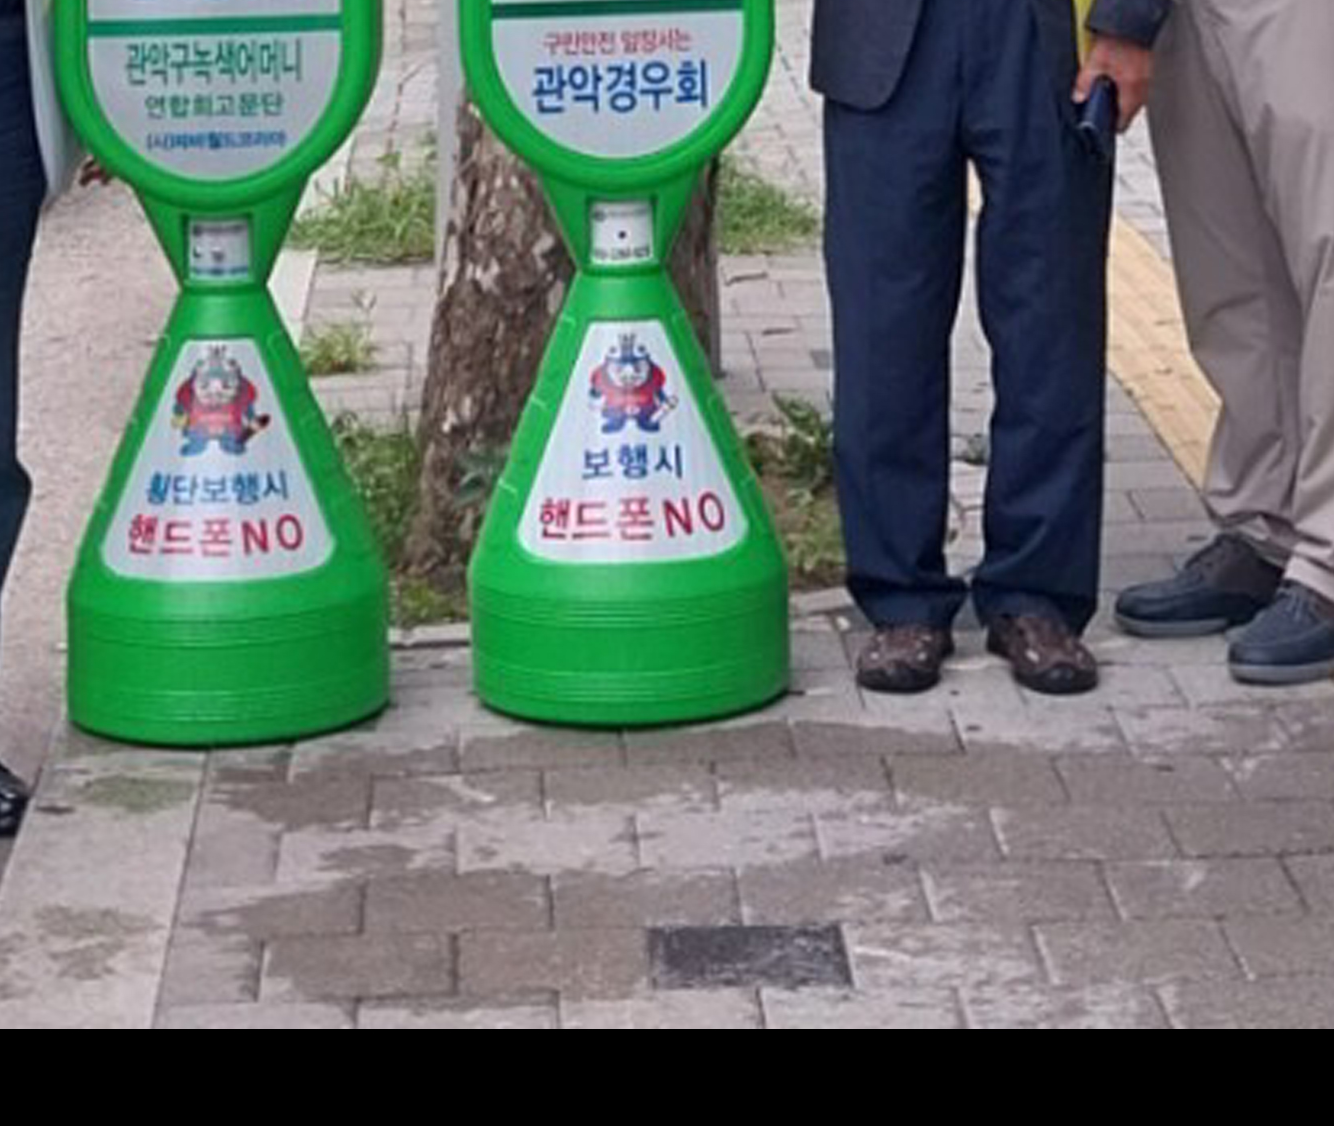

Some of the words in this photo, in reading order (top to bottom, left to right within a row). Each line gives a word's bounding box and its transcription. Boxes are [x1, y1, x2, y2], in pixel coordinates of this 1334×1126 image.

[125, 38, 303, 85] 관악구녹색어머니
[532, 59, 709, 115] 관악경우회
[582, 443, 684, 479] 보행시
[146, 470, 290, 506] 횡단보행시
[128, 513, 233, 557] 핸드폰
[242, 513, 304, 553] NO
[539, 497, 655, 541] 핸드폰
[662, 491, 726, 537] NO
